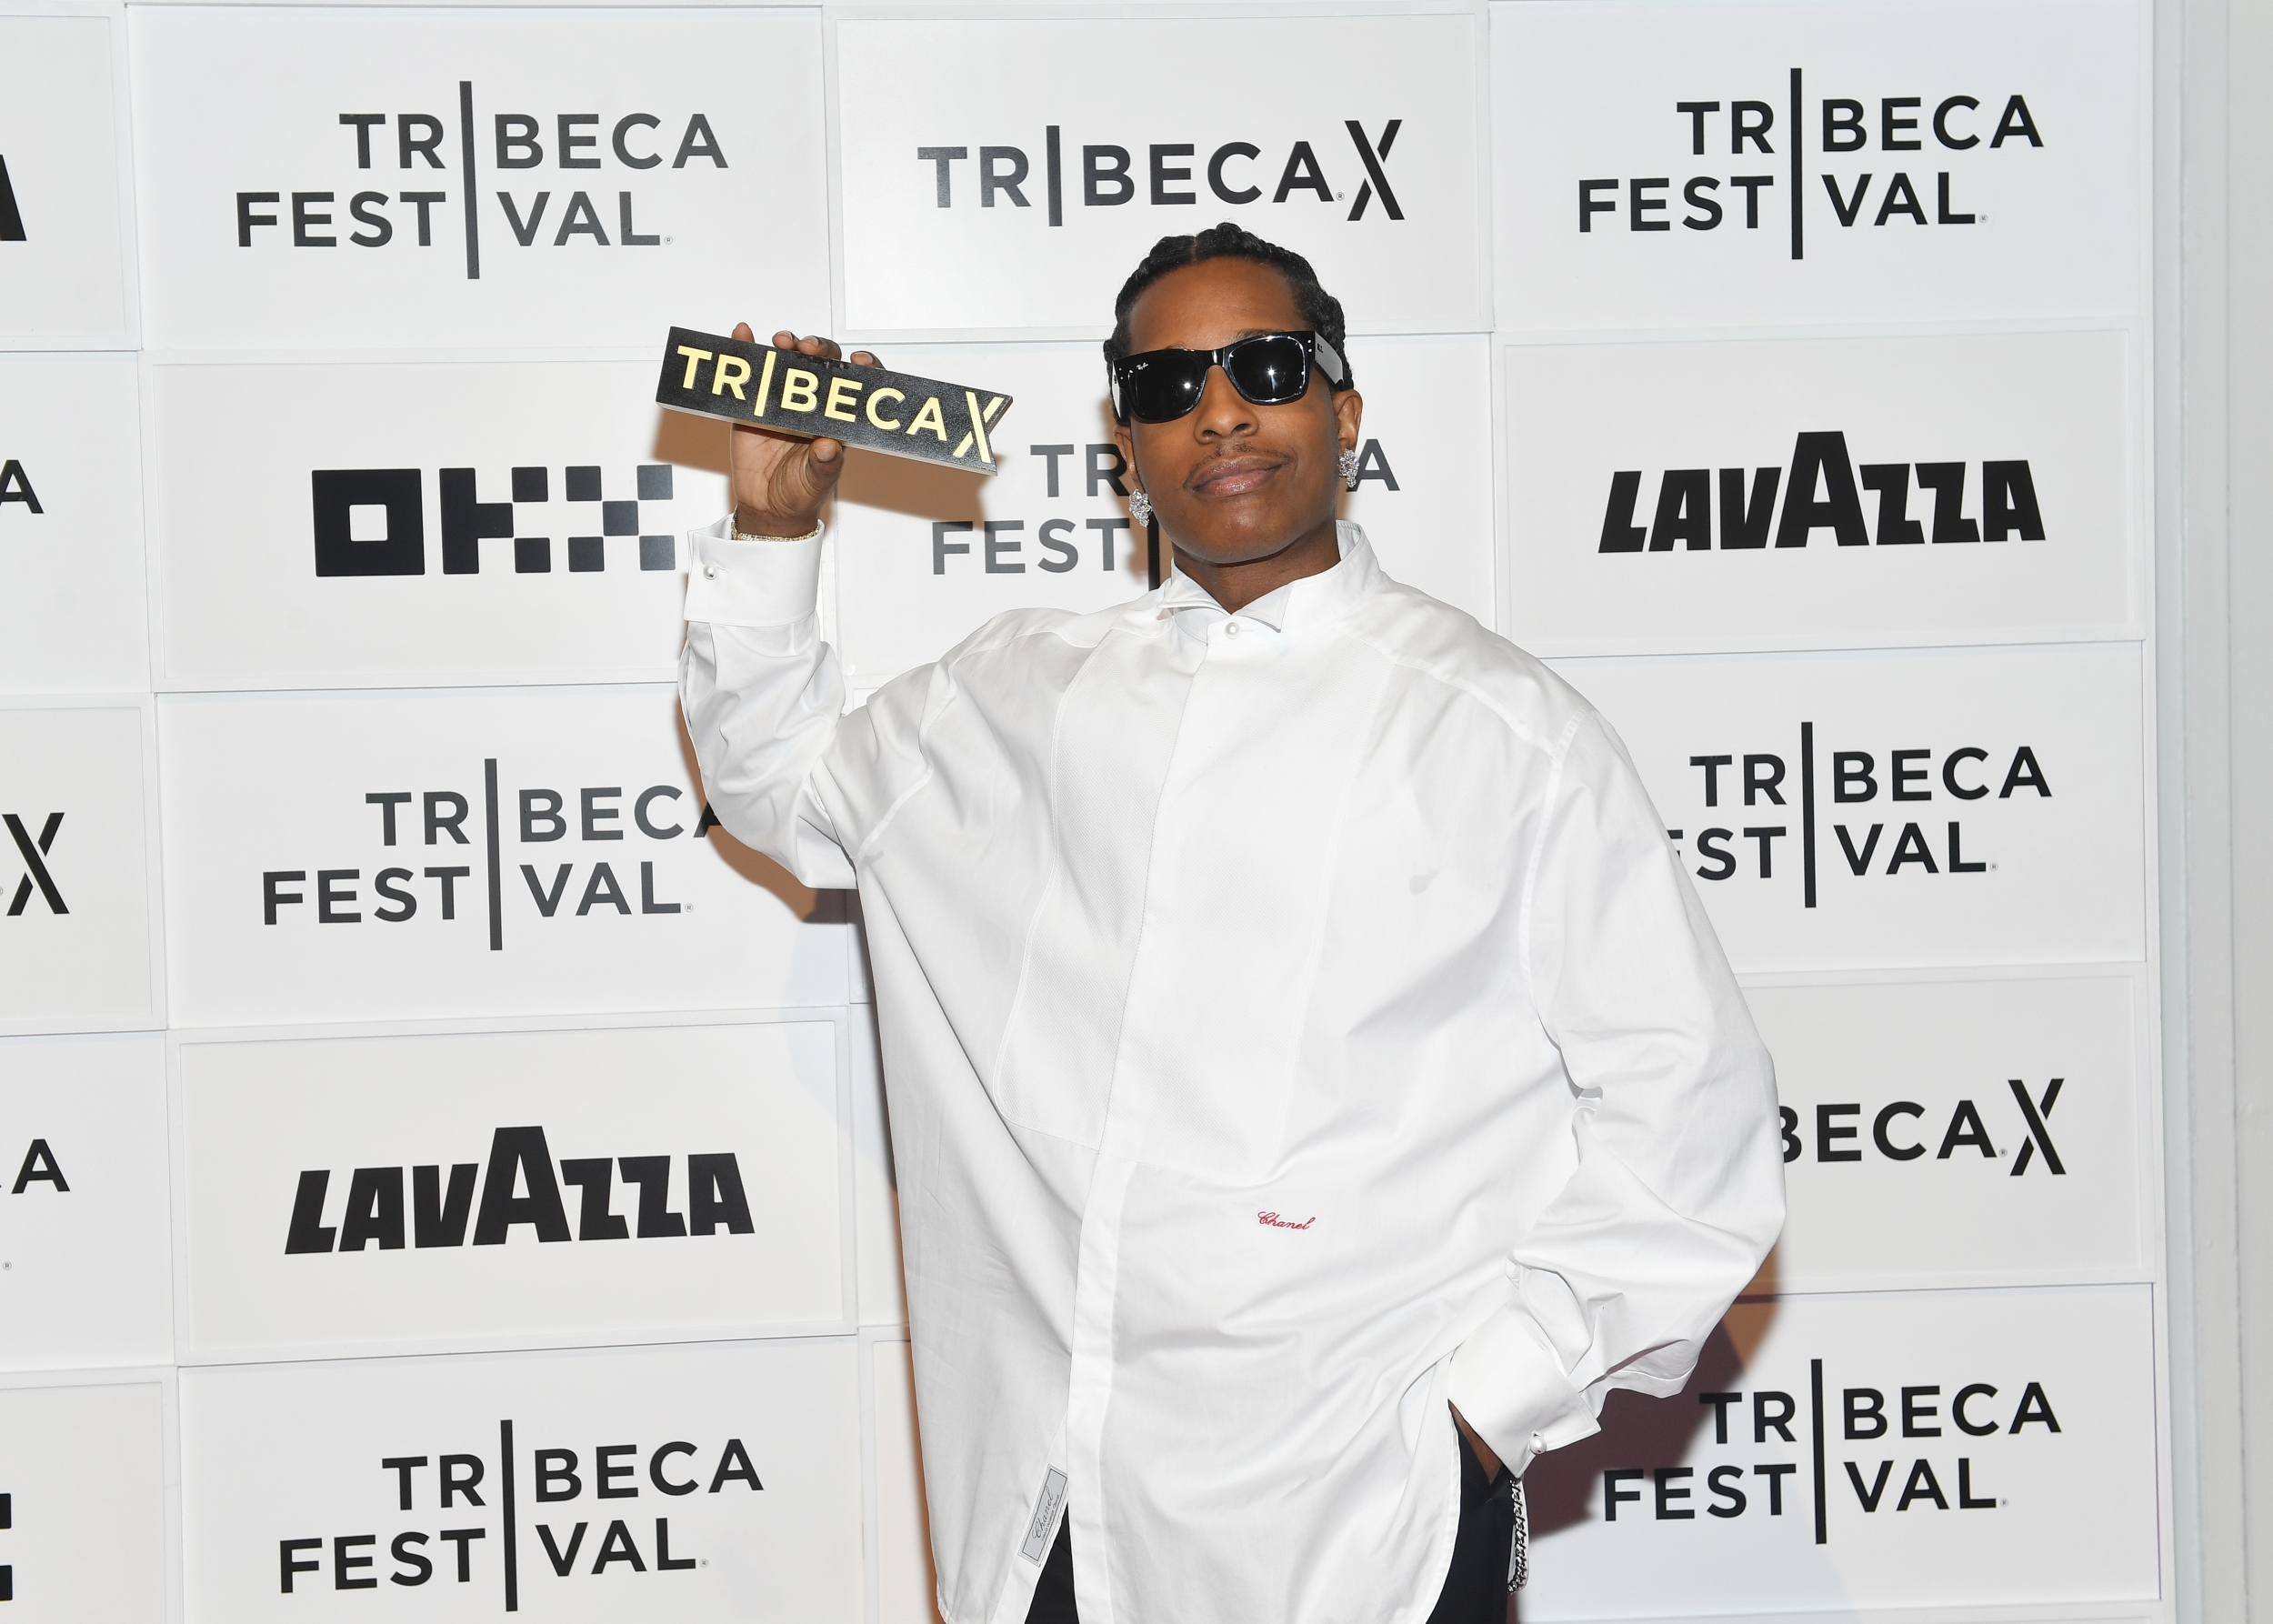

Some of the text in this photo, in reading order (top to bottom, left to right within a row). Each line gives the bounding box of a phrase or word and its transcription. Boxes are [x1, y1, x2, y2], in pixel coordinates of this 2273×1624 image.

[1597, 430, 2047, 554] LAVAZZA
[1667, 821, 1988, 908] STIVAL
[284, 1125, 756, 1255] LAVAZZA
[1257, 1211, 1316, 1230] Chanel
[1031, 1485, 1054, 1539] Chanel
